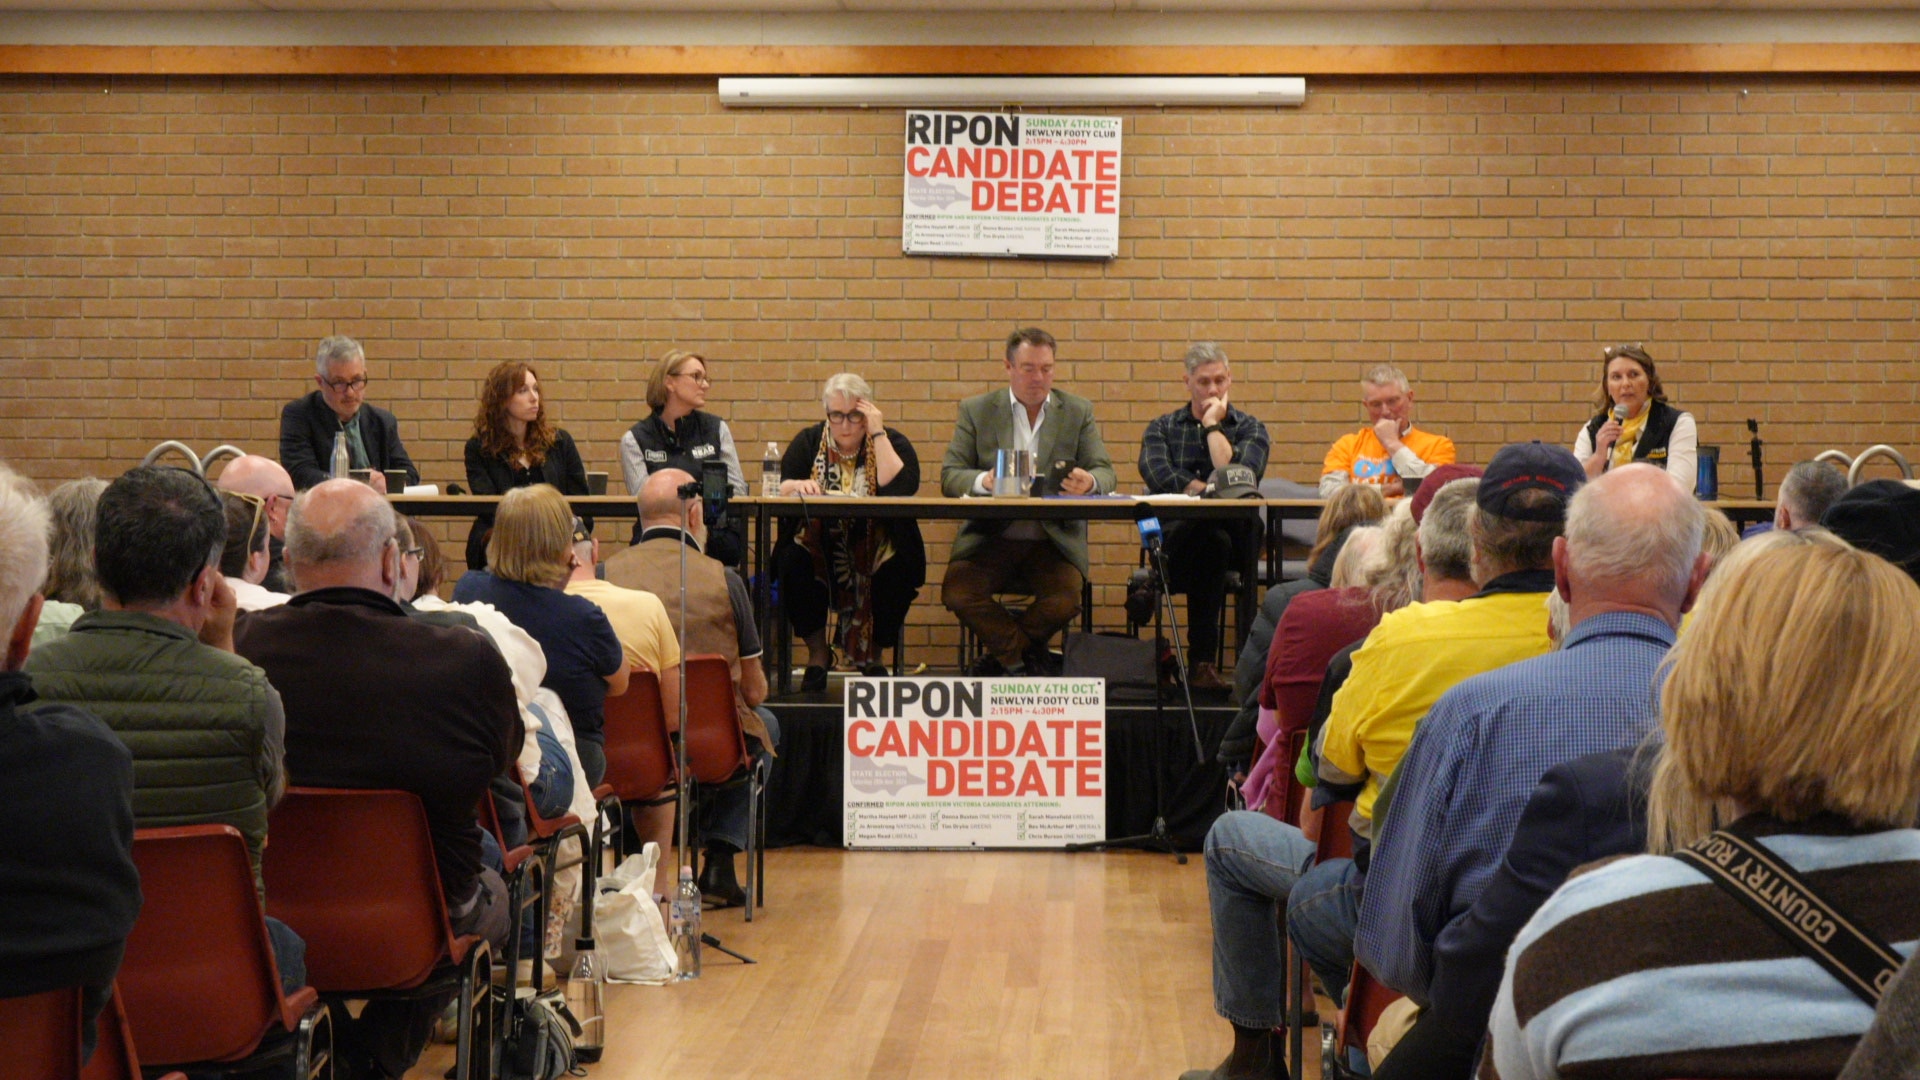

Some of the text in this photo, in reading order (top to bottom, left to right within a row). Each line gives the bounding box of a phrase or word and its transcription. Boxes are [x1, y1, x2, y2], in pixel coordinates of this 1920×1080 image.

[908, 114, 1019, 146] RIPON
[1026, 119, 1115, 129] SUNDAY 4TH OCT.
[1026, 129, 1061, 137] NEWLYN
[1094, 130, 1115, 138] CLUB
[907, 146, 1117, 181] CANDIDATE
[971, 181, 1116, 214] DEBATE
[848, 681, 982, 718] RIPON
[990, 684, 1098, 694] SUNDAY 4TH OCT.
[990, 696, 1100, 705] NEWLYN FOOTY CLUB
[990, 707, 1023, 715] 2:15PM
[1032, 707, 1065, 715] 4:30PM
[848, 720, 1102, 757] CANDIDATE
[927, 760, 1102, 797] DEBATE
[1731, 858, 1837, 943] COUNTRY
